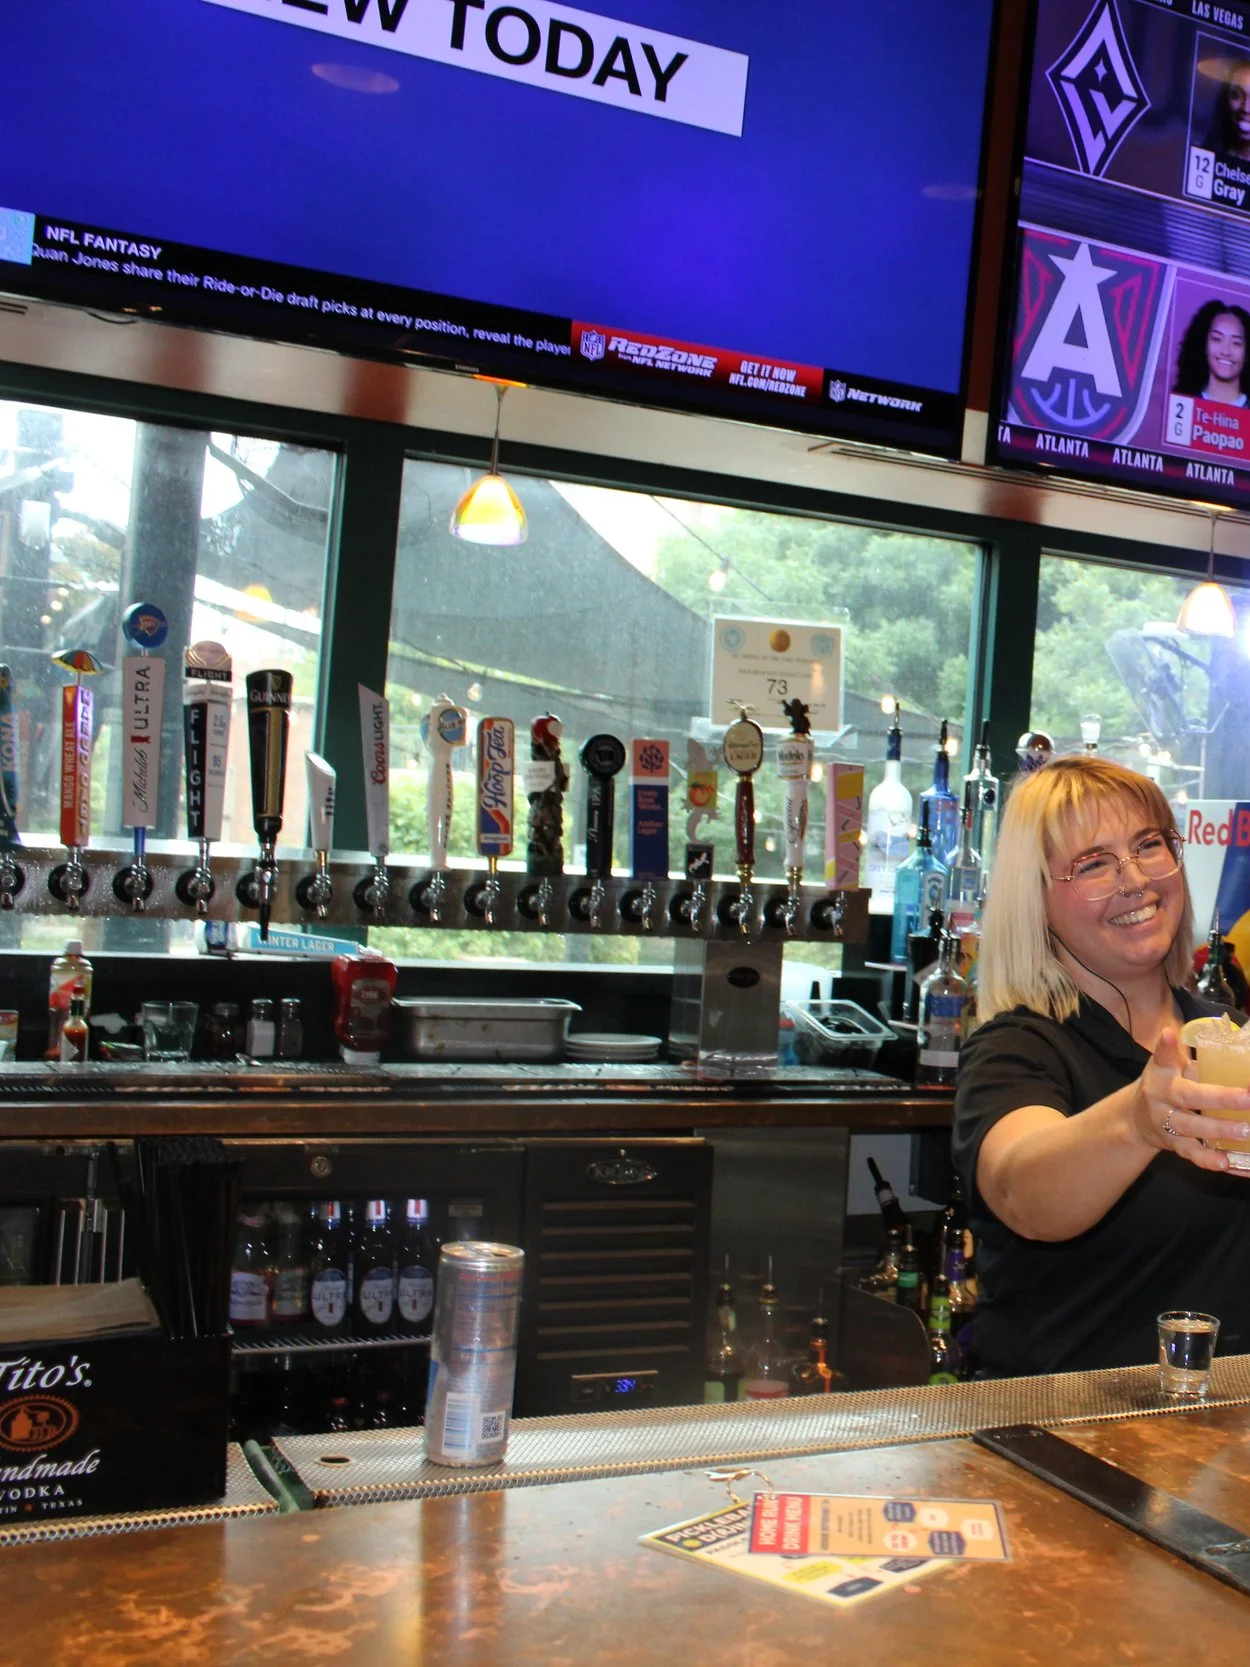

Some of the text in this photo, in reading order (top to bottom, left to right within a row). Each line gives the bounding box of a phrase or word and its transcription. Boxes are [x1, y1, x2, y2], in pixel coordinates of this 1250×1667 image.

[1192, 0, 1244, 30] LAS VEGAS
[436, 0, 688, 103] TODAY
[1194, 155, 1210, 174] 12
[1214, 180, 1245, 207] Gray
[46, 224, 163, 261] NFL FANTASY
[72, 253, 119, 273] Jones
[121, 260, 164, 281] share
[167, 269, 201, 287] their
[203, 275, 284, 304] Ride-or-Die
[287, 292, 319, 310] draft
[322, 299, 357, 318] picks
[360, 306, 374, 320] at
[377, 310, 413, 329] every
[415, 317, 470, 340] position,
[473, 327, 510, 345] reveal
[513, 334, 533, 349] the
[632, 356, 653, 367] NFL
[655, 361, 713, 378] NETWORK
[739, 360, 796, 382] GET IT NOW
[729, 373, 807, 398] NFL.COM/REDZONE
[847, 387, 923, 413] NETWORK
[1176, 403, 1184, 420] 2
[1194, 407, 1240, 430] Te-Hina
[1035, 432, 1089, 458] ATLANTA
[1192, 423, 1244, 451] Paopao
[1112, 448, 1164, 473] ATLANTA
[1185, 461, 1235, 486] ATLANTA
[190, 668, 229, 681] FLIGHT
[766, 678, 788, 695] 73
[133, 666, 151, 731] ULTRA
[370, 704, 386, 786] Coors LIGHT
[62, 721, 76, 809] MANGO WHEAT ALE
[189, 709, 201, 826] FLIGHT
[483, 726, 512, 809] Hoop Tea
[1188, 808, 1234, 847] Red
[302, 938, 335, 953] LAGER
[0, 1355, 91, 1392] Tito's
[0, 1449, 101, 1483] ndmade
[42, 1499, 83, 1510] TEXAS
[758, 1519, 779, 1546] HOME
[782, 1497, 804, 1551] DRINK MENU
